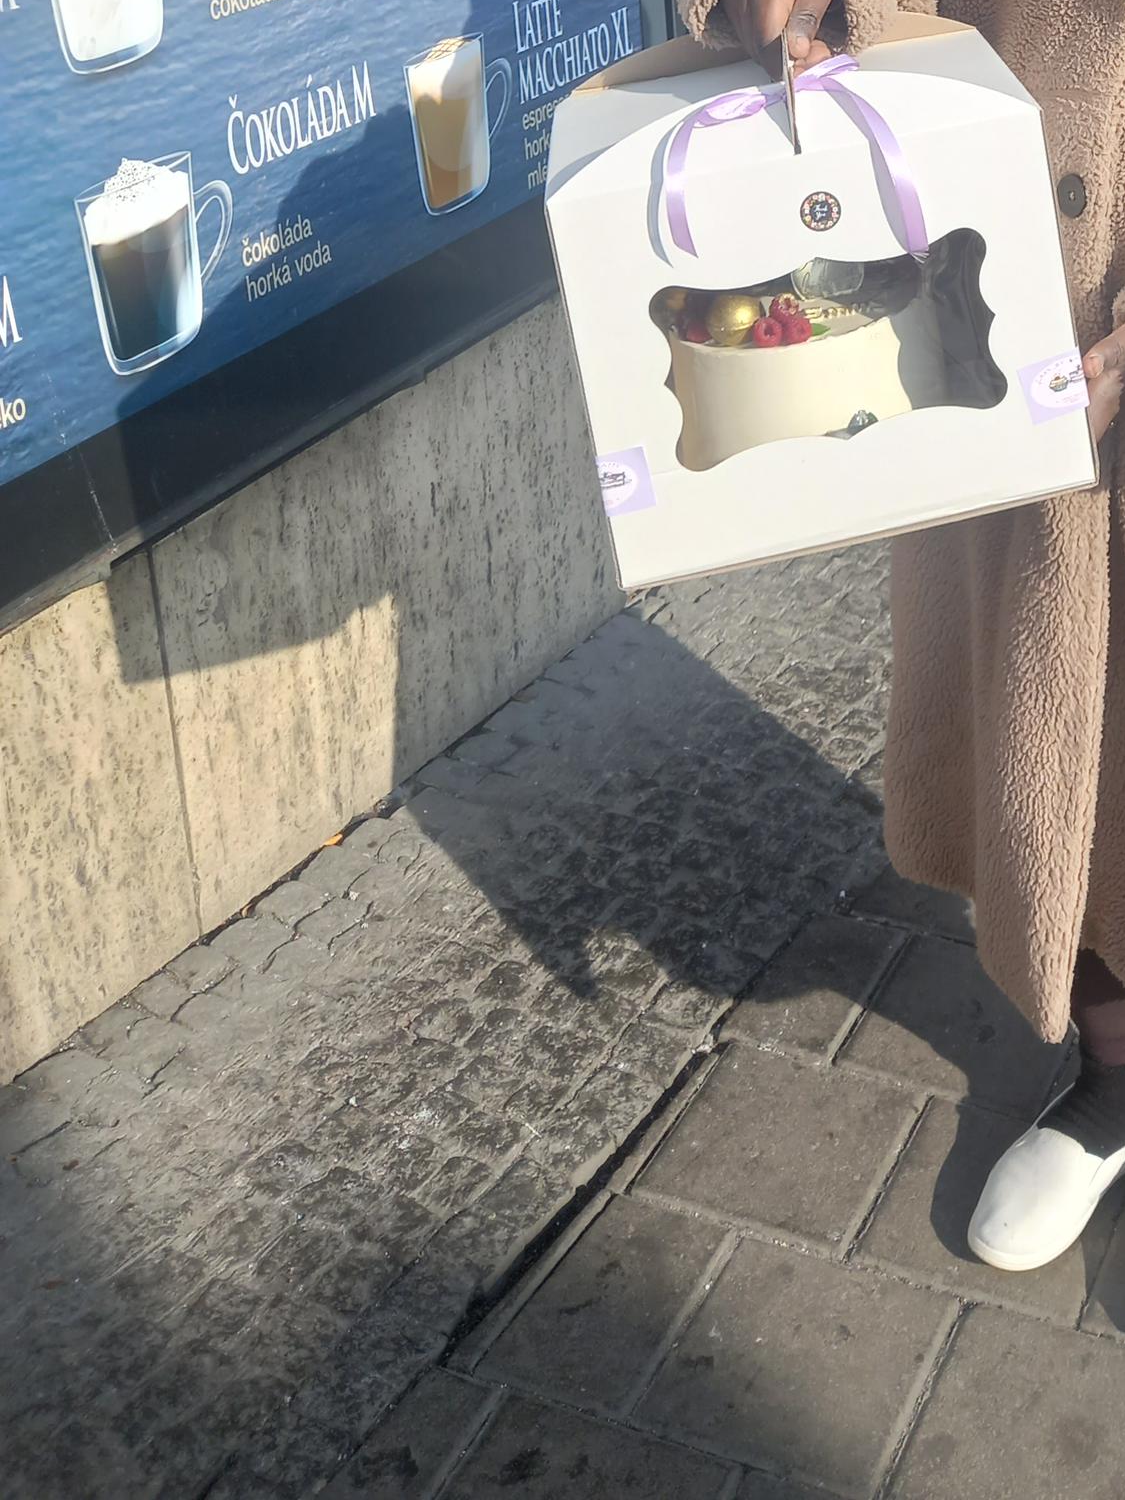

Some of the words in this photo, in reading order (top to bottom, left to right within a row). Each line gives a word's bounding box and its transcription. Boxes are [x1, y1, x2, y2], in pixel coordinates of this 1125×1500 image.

[519, 23, 610, 105] MACCHIATO
[611, 7, 633, 61] XL
[227, 74, 352, 175] ČOKOLÁDA
[351, 60, 377, 125] M
[522, 92, 572, 132] espre
[524, 129, 550, 160] hork
[527, 157, 548, 190] mlé
[242, 214, 312, 267] čokoláda
[246, 255, 292, 302] horká
[294, 240, 332, 276] voda
